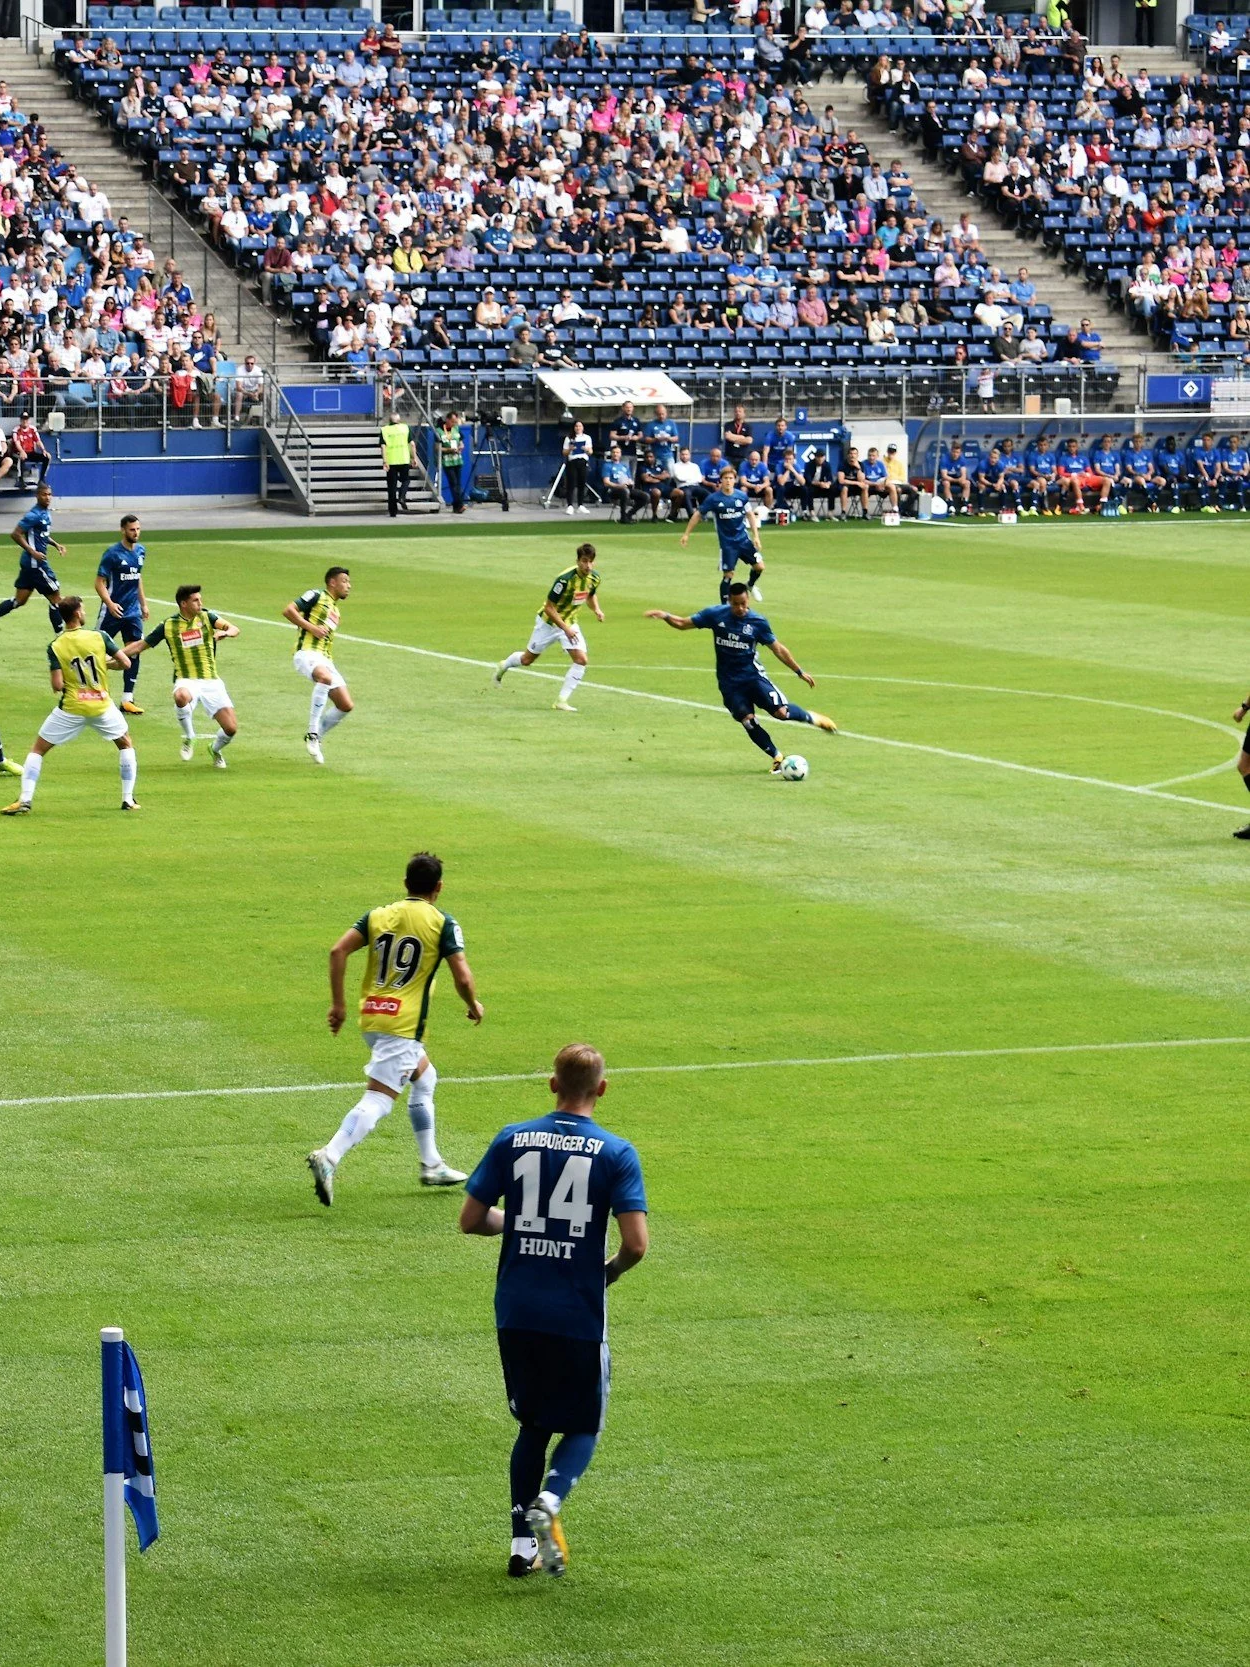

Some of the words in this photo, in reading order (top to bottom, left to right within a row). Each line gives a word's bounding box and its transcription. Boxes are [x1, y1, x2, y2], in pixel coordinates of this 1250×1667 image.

[570, 385, 638, 399] NDR
[640, 387, 663, 398] 2
[798, 411, 805, 420] 3
[716, 636, 750, 650] Emirates
[70, 655, 100, 688] 11
[373, 931, 423, 989] 19
[512, 1131, 585, 1152] HAMBURGER
[585, 1137, 606, 1155] SV
[513, 1150, 593, 1238] 14
[518, 1237, 576, 1260] HUNT
